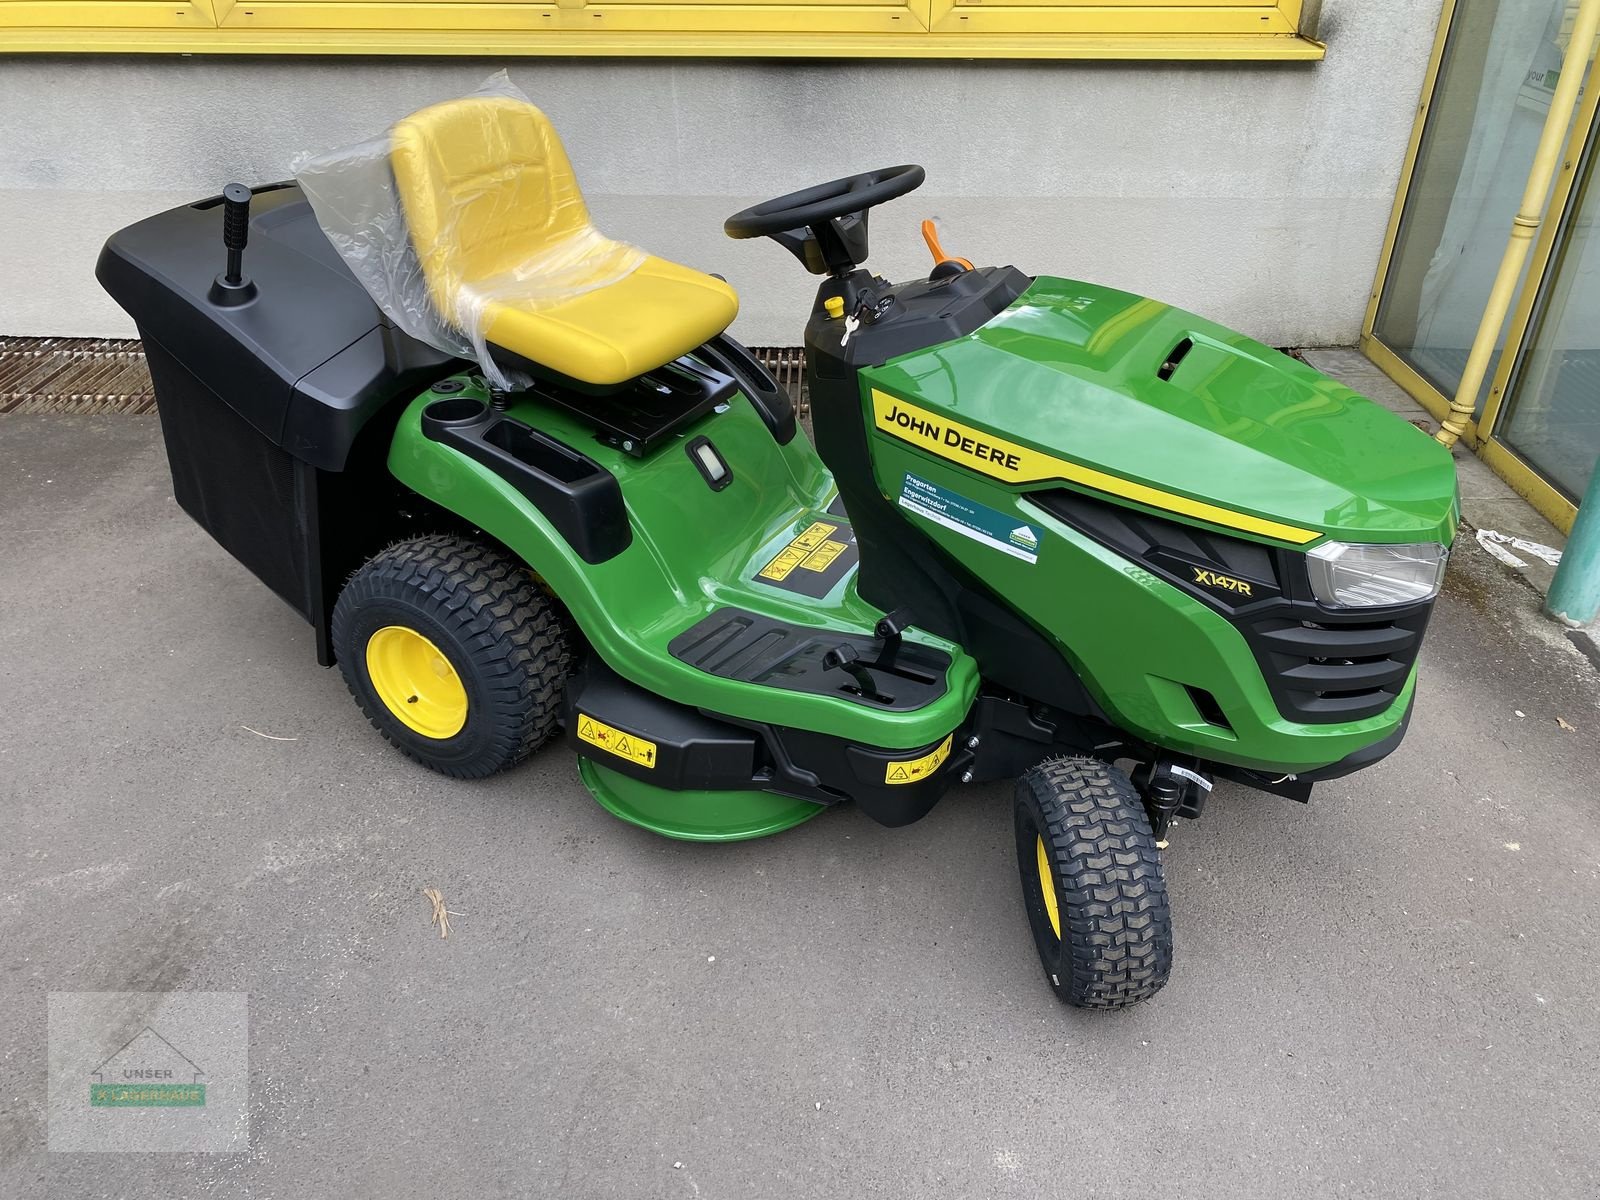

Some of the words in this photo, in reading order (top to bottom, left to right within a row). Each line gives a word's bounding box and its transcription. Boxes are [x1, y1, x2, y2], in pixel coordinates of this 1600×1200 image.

[1526, 70, 1544, 82] your
[884, 406, 940, 441] JOHN
[943, 427, 1021, 471] DEERE
[906, 474, 937, 493] Pregarten
[903, 486, 947, 511] Engerwitzdorf
[1193, 567, 1252, 596] X147R
